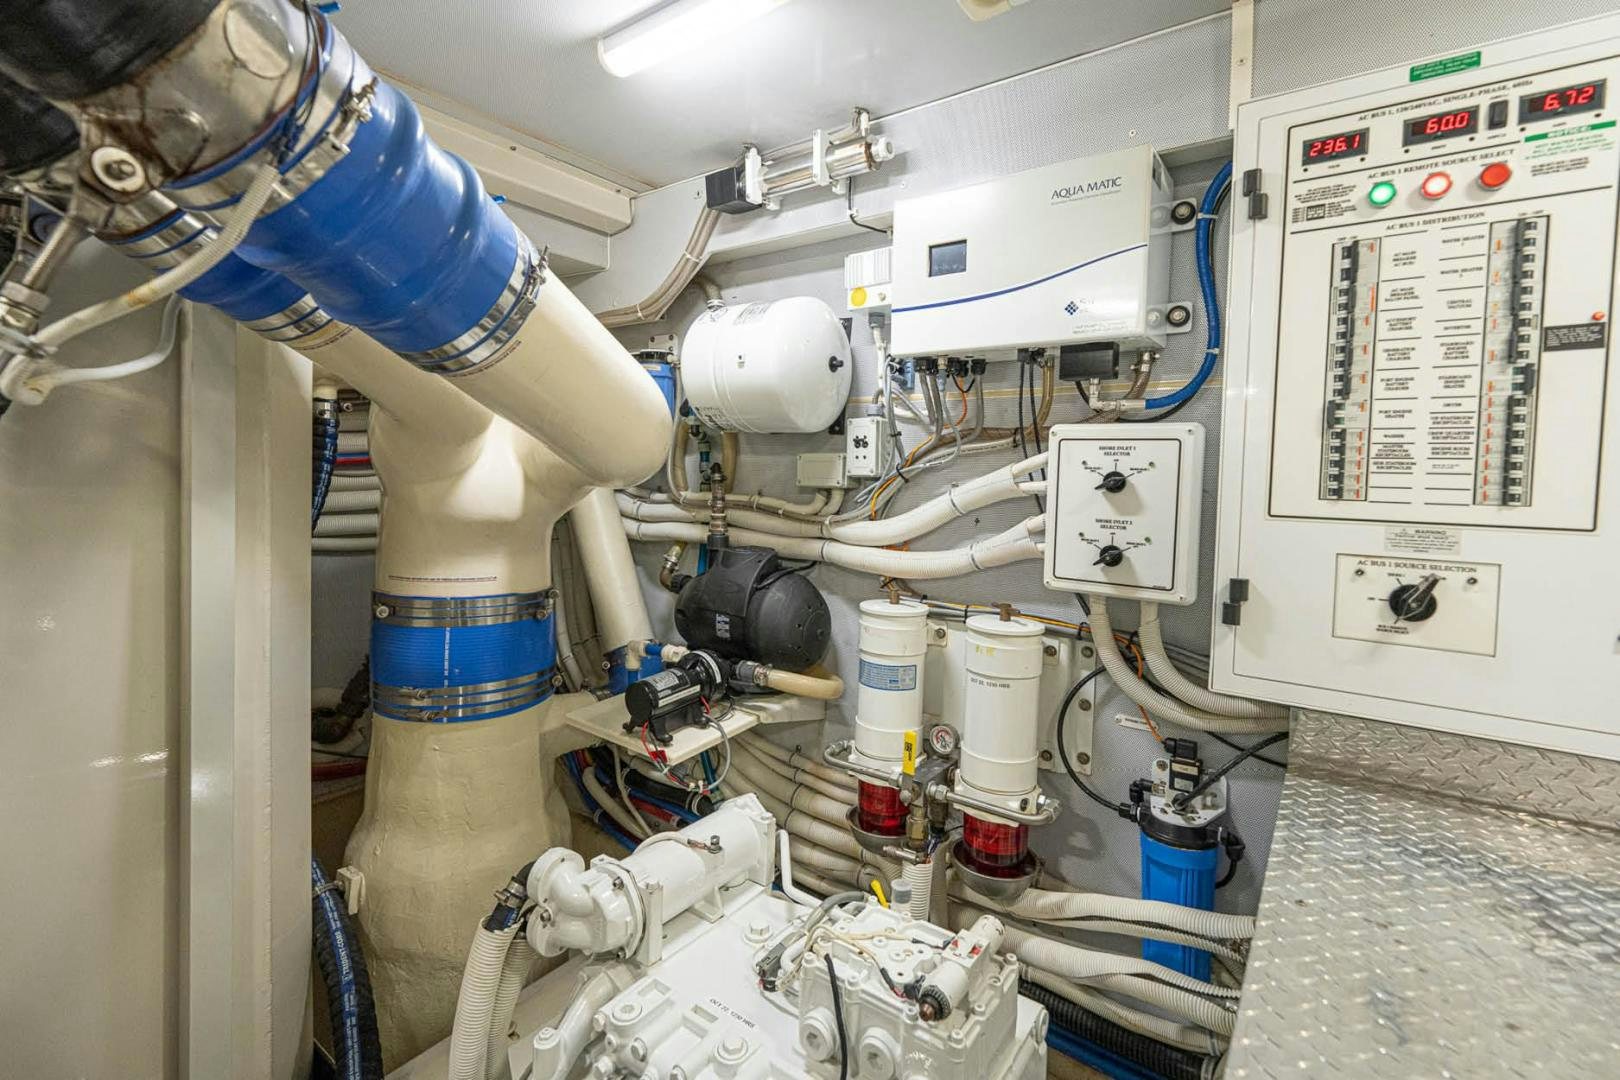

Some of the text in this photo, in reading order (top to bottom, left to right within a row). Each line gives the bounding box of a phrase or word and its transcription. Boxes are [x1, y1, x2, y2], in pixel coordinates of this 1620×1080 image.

[1358, 113, 1369, 122] AC
[1370, 111, 1387, 119] BUS
[1310, 134, 1360, 156] 236.1
[1403, 162, 1440, 173] REMOTE
[1442, 156, 1476, 167] SOURCE
[1480, 150, 1514, 160] SELECT
[1051, 184, 1084, 200] AQUA
[1086, 176, 1122, 192] MATIC
[1422, 212, 1486, 226] DISTRIBUTION
[1394, 562, 1427, 570] SOURCE
[1429, 564, 1477, 573] SELECTION
